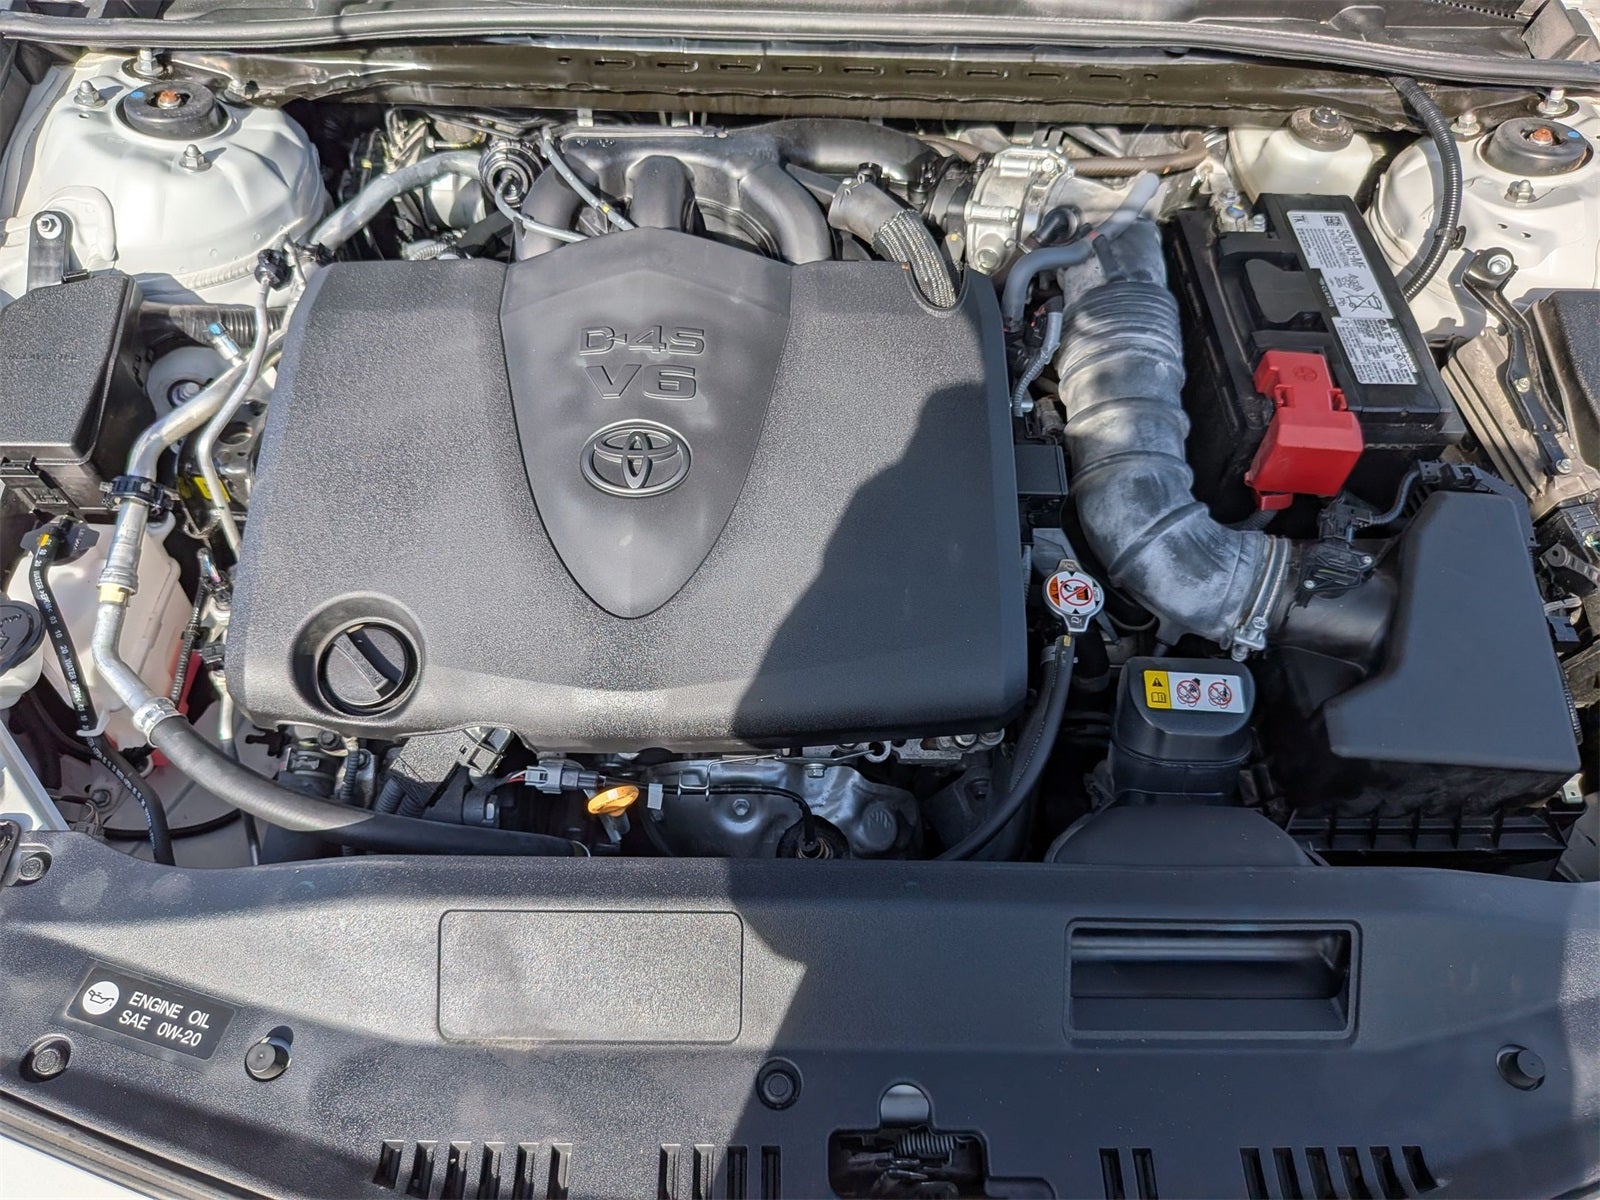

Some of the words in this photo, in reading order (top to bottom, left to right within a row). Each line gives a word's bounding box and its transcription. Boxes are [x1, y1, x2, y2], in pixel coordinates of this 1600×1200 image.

[585, 363, 697, 401] V6
[60, 644, 69, 655] 20
[64, 658, 77, 681] WATER
[119, 1010, 151, 1030] SAE
[157, 1022, 202, 1047] 0W-20
[129, 991, 184, 1019] ENGINE
[188, 1010, 210, 1029] OIL
